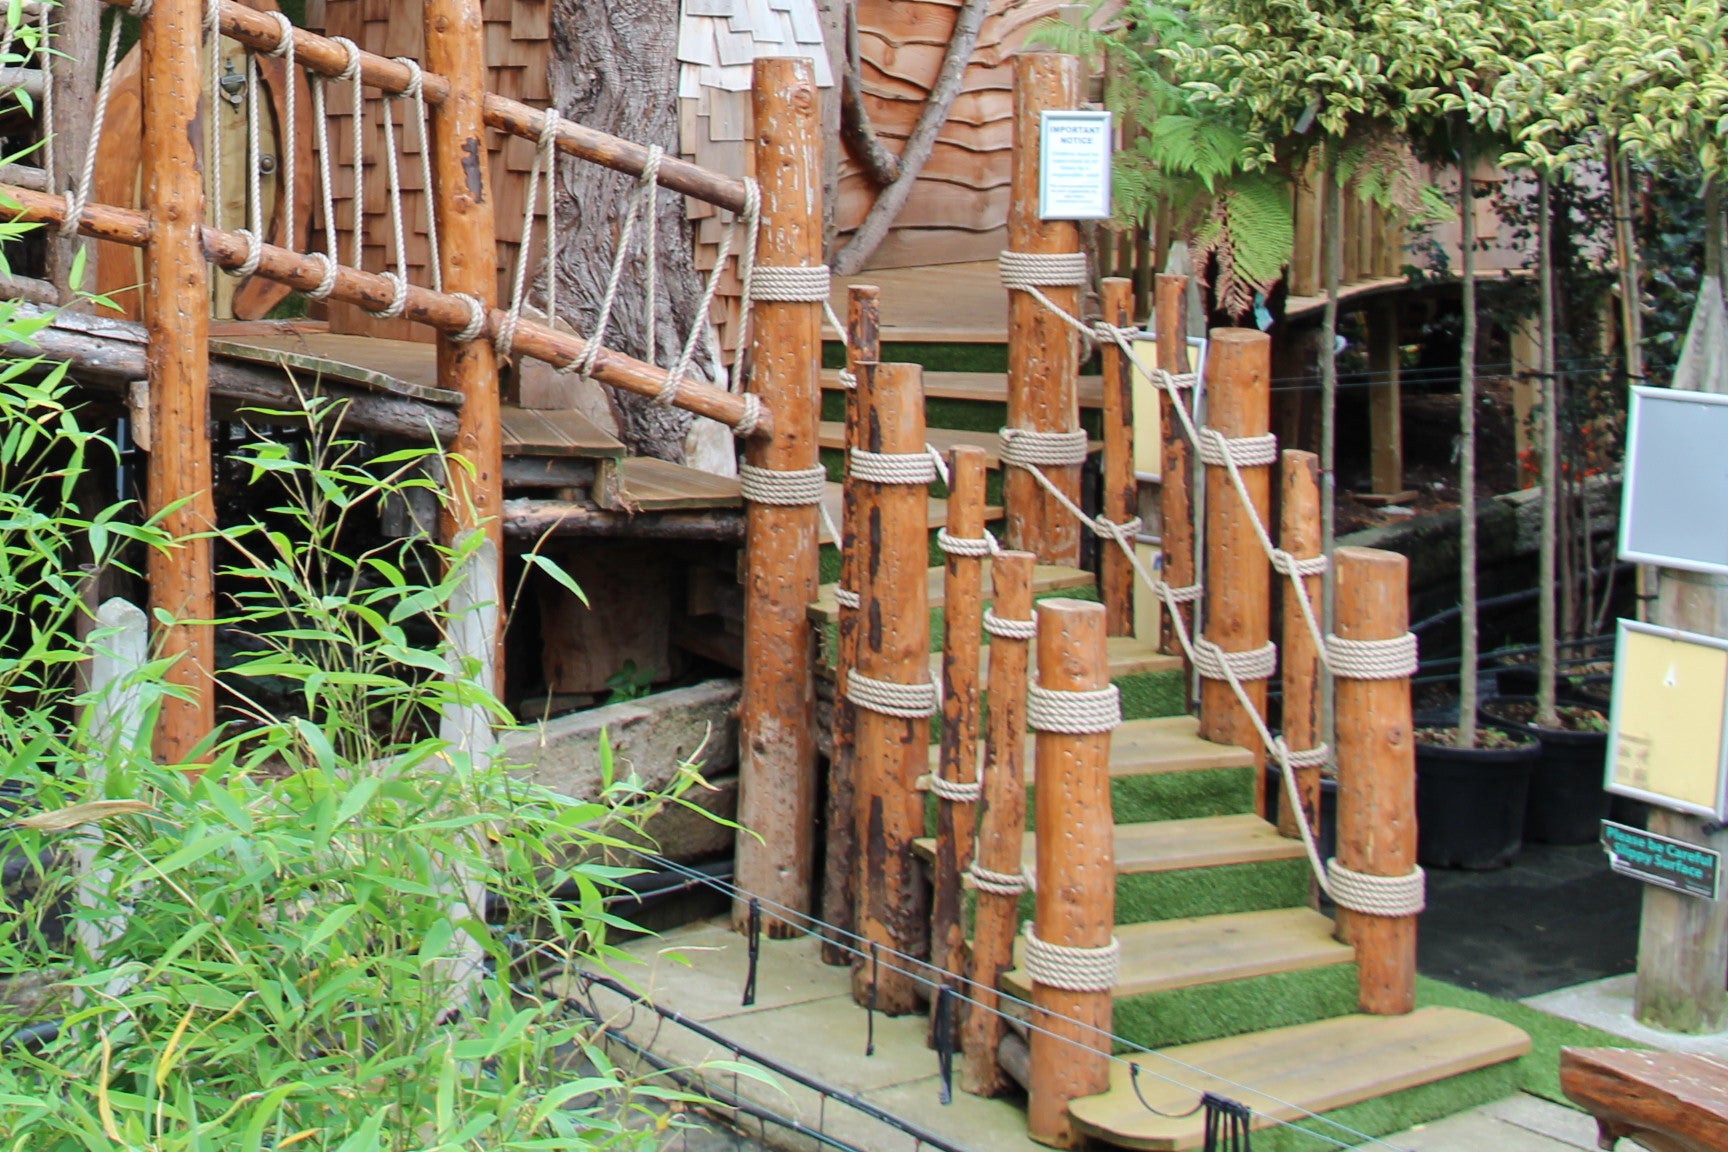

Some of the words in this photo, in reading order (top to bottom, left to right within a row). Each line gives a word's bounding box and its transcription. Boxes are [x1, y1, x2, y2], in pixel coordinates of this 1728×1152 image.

[1050, 126, 1100, 134] IMPORTANT
[1605, 826, 1646, 847] Please
[1647, 838, 1664, 853] be
[1666, 844, 1713, 867] Careful
[1614, 841, 1653, 866] Slippy
[1653, 854, 1704, 879] Surface
